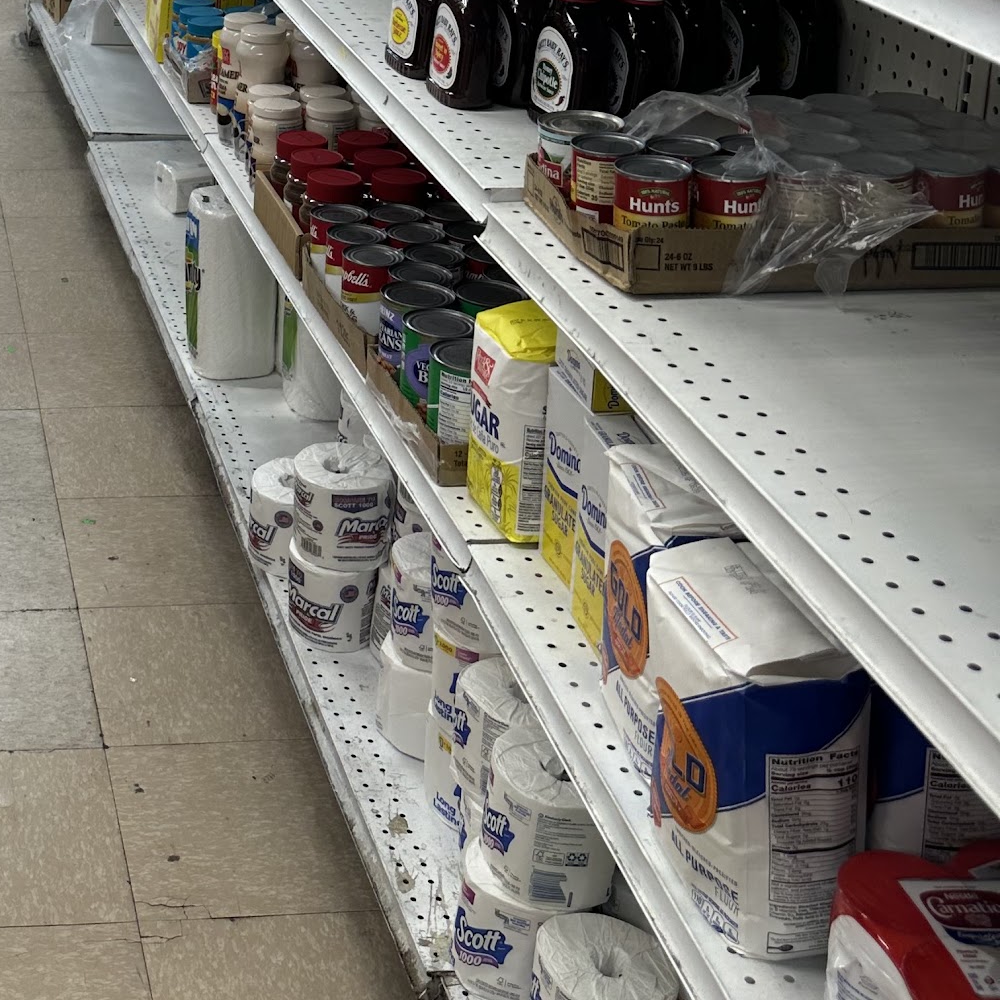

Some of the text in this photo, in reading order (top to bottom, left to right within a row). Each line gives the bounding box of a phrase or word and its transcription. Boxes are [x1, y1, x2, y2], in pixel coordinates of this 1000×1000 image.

[683, 252, 693, 261] OZ
[664, 263, 679, 271] NET
[680, 263, 691, 271] WT
[699, 263, 714, 271] LBS
[334, 501, 354, 510] SCOTT
[431, 568, 461, 594] Scott
[433, 595, 450, 607] 1000
[609, 561, 642, 643] GOLD
[615, 678, 655, 744] ALL PURPOSE
[771, 749, 859, 766] Nutrition Facts
[771, 774, 858, 792] Calories 110
[670, 829, 740, 902] ALL PURPOSE
[456, 914, 501, 951] Scott
[458, 950, 482, 967] 1000
